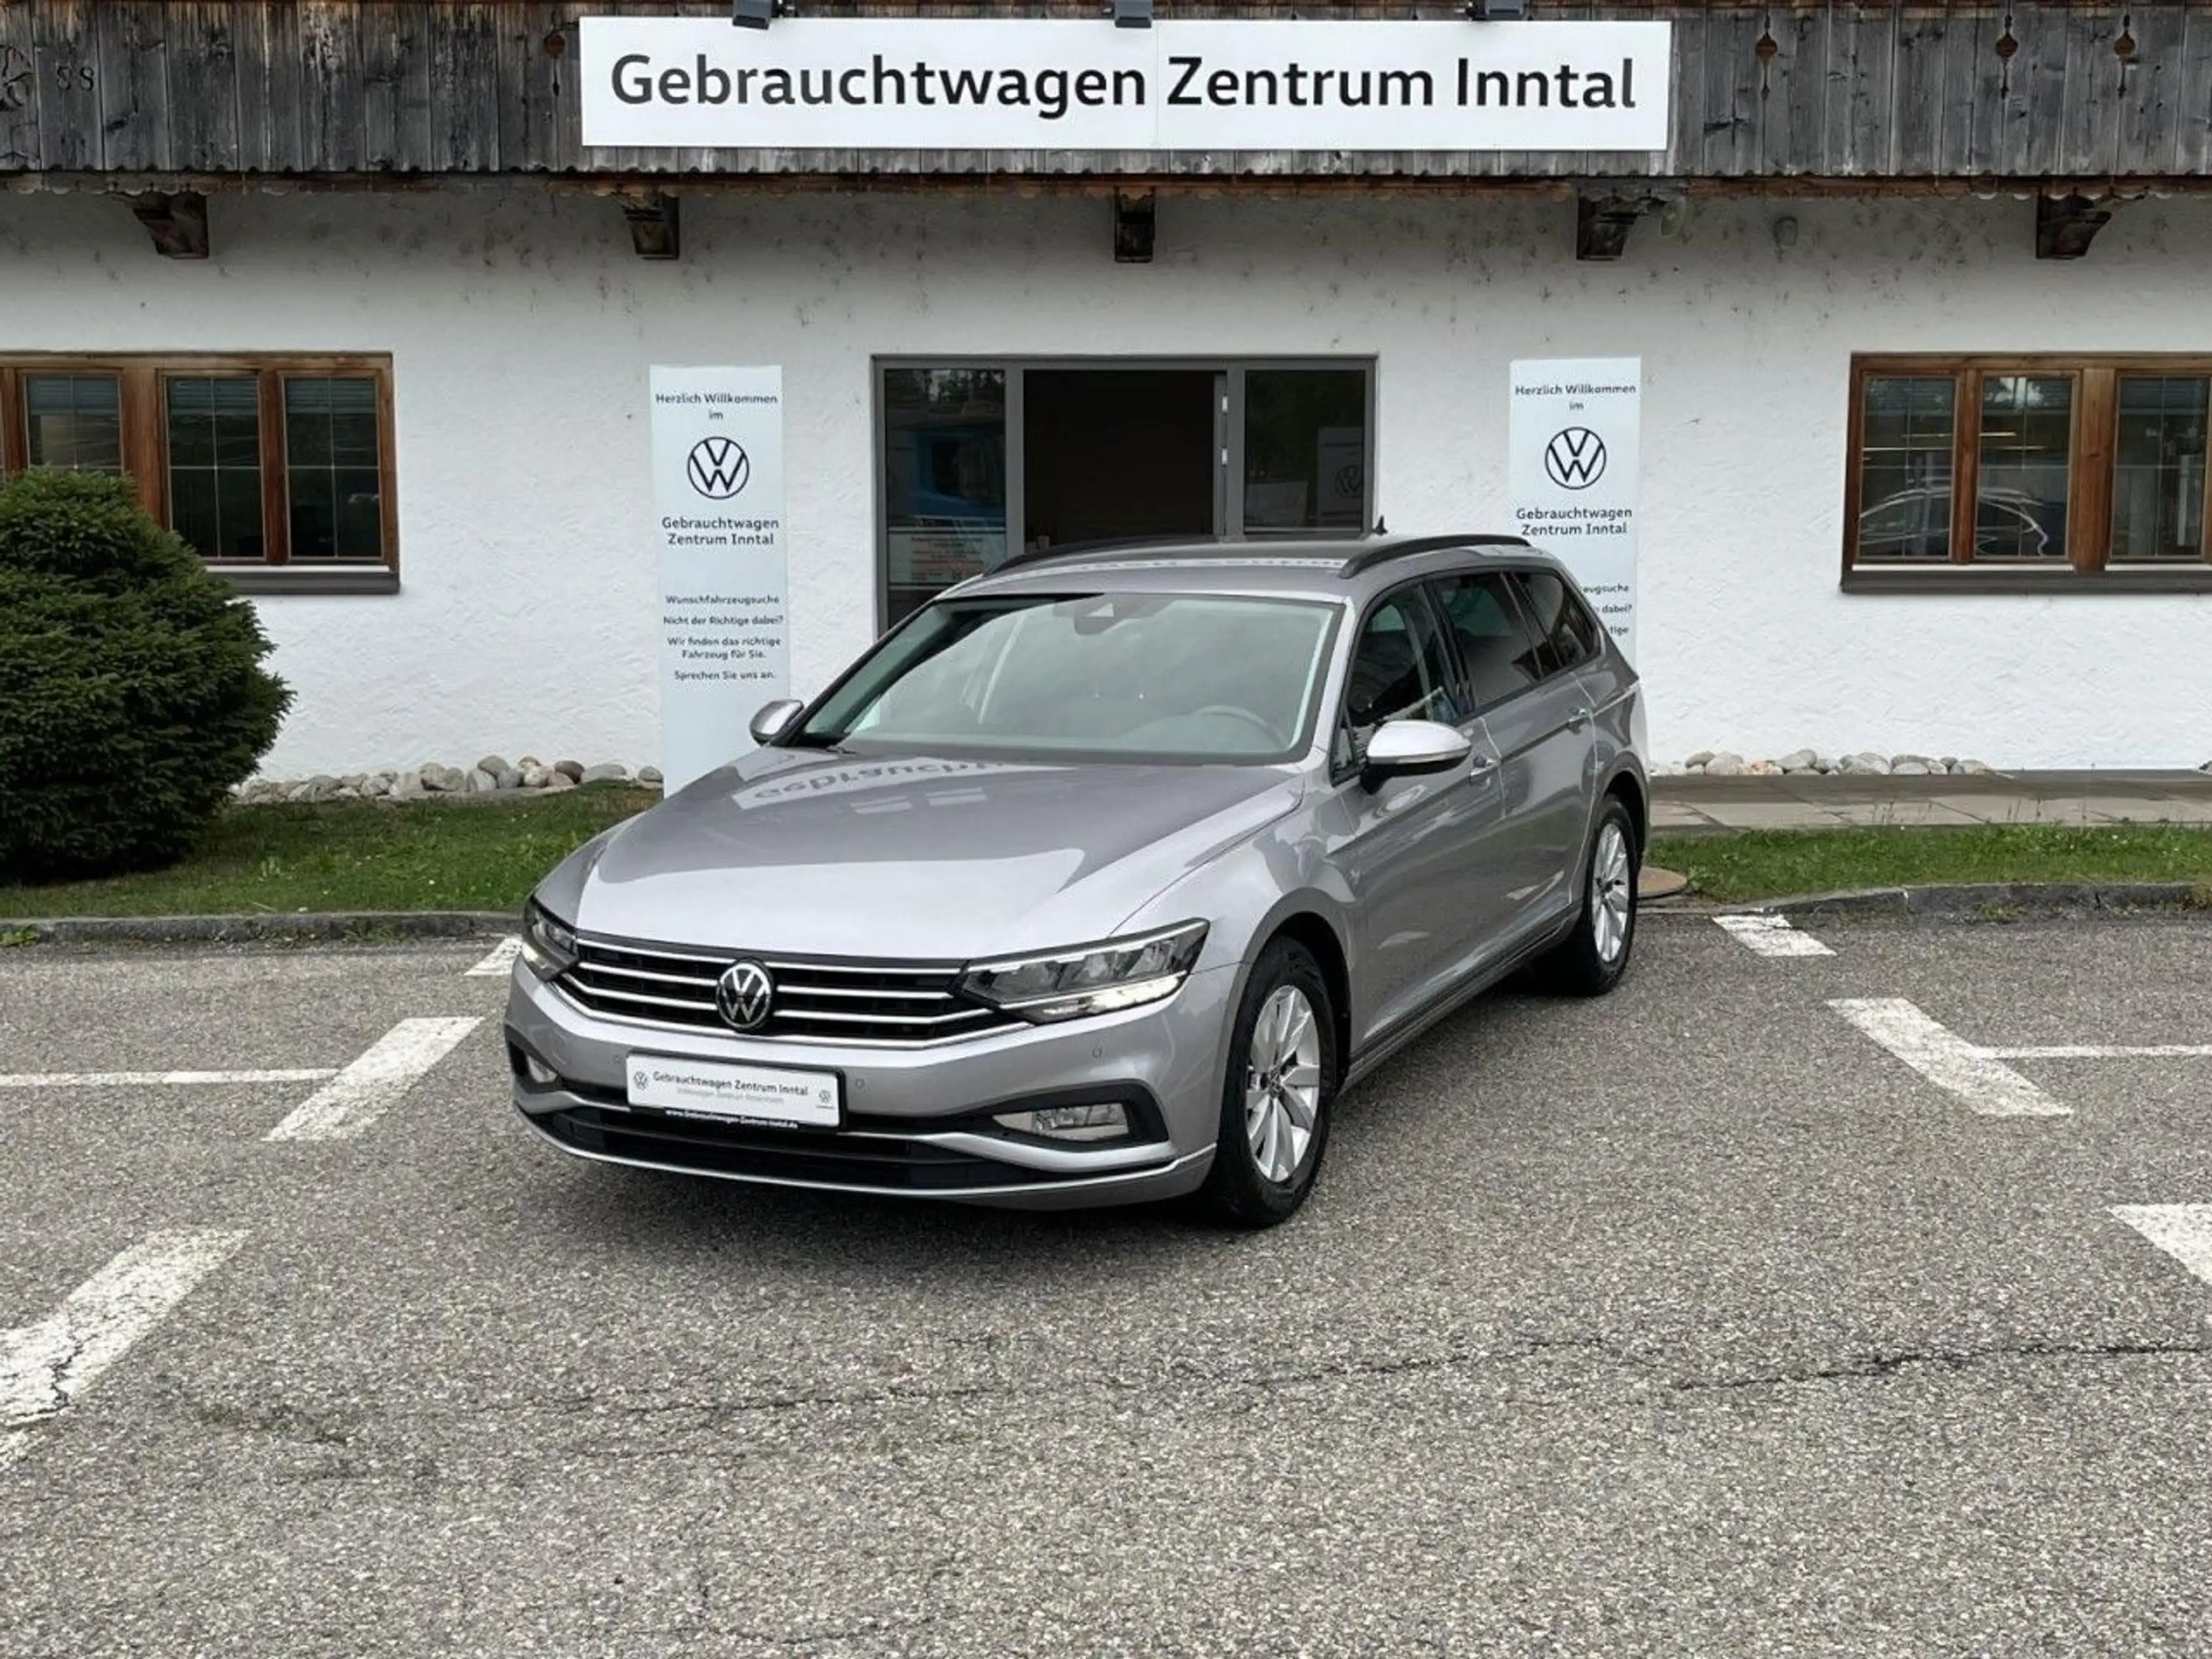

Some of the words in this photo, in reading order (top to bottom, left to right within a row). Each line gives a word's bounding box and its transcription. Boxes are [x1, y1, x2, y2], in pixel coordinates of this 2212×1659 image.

[611, 53, 1145, 120] Gebrauchtwagen
[1166, 56, 1434, 107] Zentrum
[1456, 57, 1637, 109] Inntal
[1516, 385, 1562, 395] Herzlich
[1565, 384, 1637, 395] Willkommen
[656, 393, 701, 403] Herzlich
[703, 393, 778, 403] Willkommen
[1569, 402, 1584, 411] im
[709, 410, 724, 419] im
[1545, 426, 1607, 490] VW
[687, 436, 749, 500] VW
[1516, 507, 1633, 521] Gebrauchtwagen
[662, 516, 779, 531] Gebrauchtwagen
[1521, 523, 1582, 536] Zentrum
[1585, 522, 1627, 535] Inntal
[668, 533, 727, 546] Zentrum
[731, 533, 774, 546] Inntal
[665, 595, 780, 605] Wunschfahrzeugsuche
[1601, 604, 1633, 613] dabei?
[663, 616, 689, 625] Nicht
[691, 616, 707, 625] der
[709, 616, 749, 626] Richtige
[752, 615, 784, 625] dabei?
[667, 637, 685, 645] Wir
[687, 637, 720, 645] finden
[721, 637, 740, 645] das
[742, 636, 781, 646] richtige
[681, 649, 729, 661] Fahrzeug
[730, 649, 747, 659] für
[674, 670, 720, 681] Sprechen
[722, 671, 738, 680] Sie
[740, 672, 758, 680] uns
[715, 963, 771, 1028] VW
[653, 1070, 733, 1089] Gebrauchtwagen
[734, 1079, 778, 1093] Zentrum
[779, 1084, 809, 1096] Inntal
